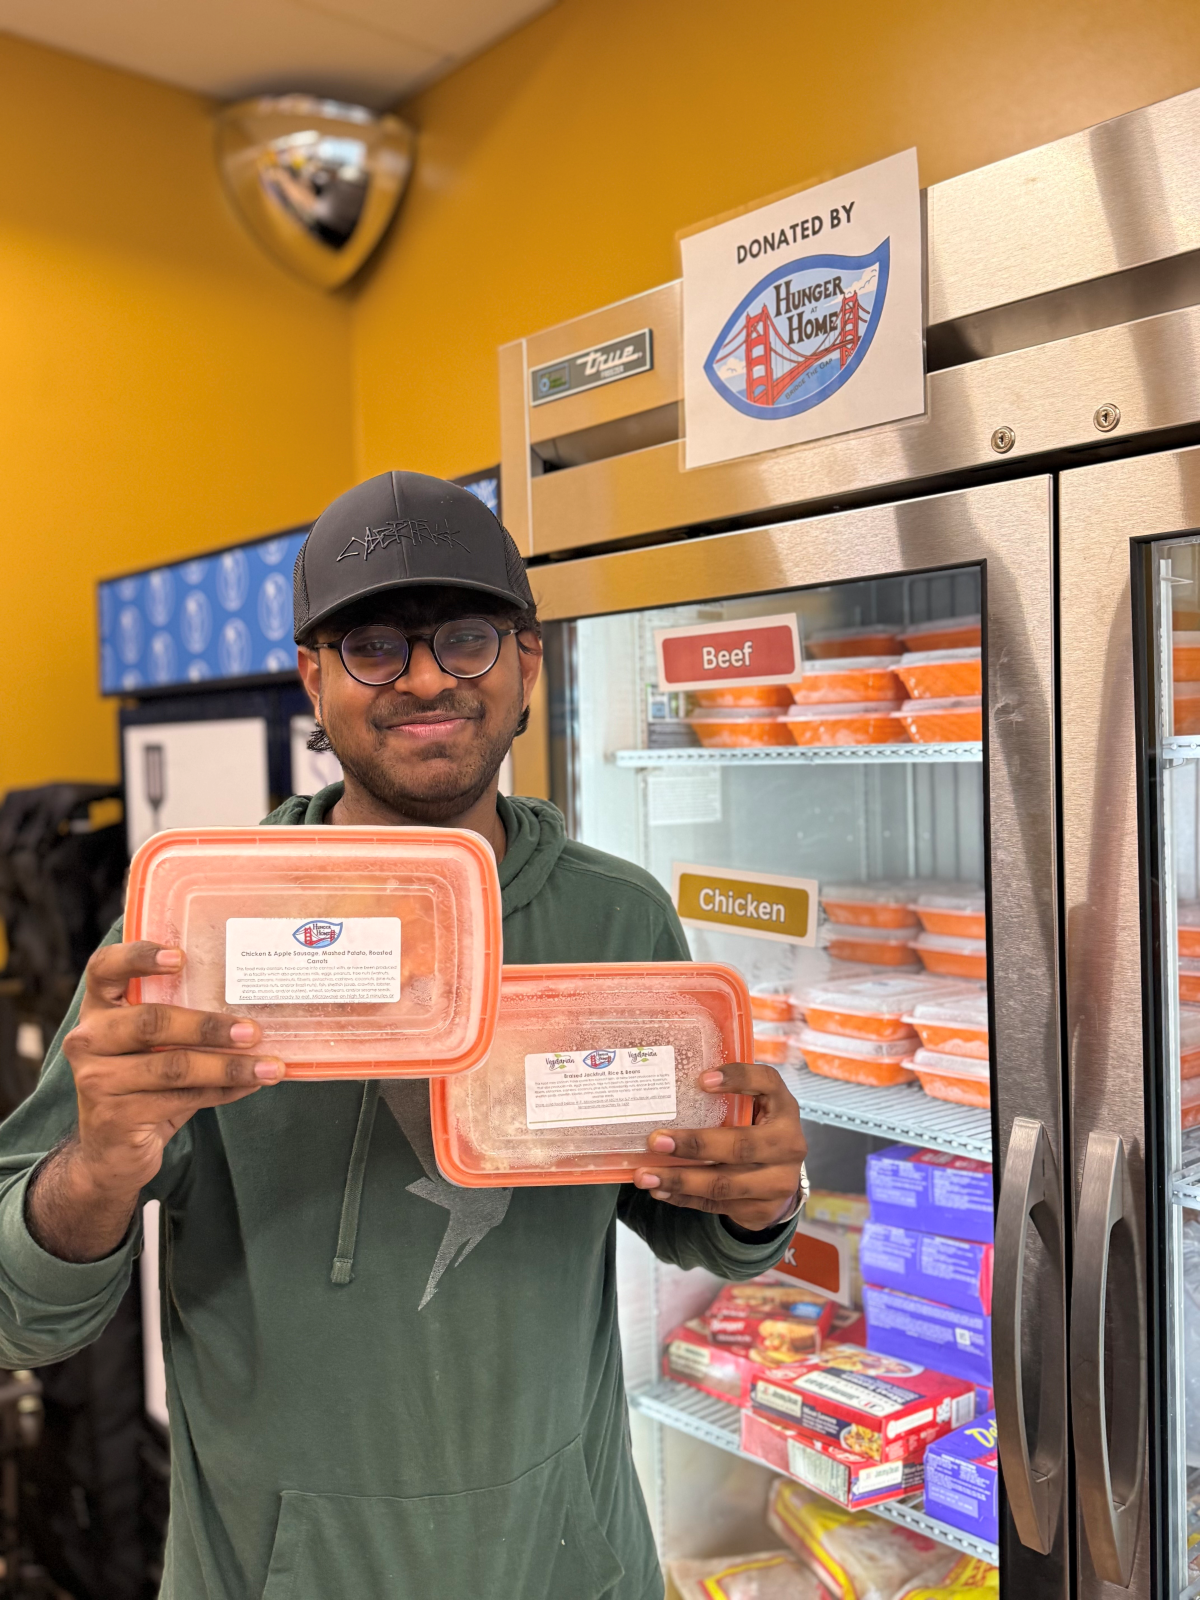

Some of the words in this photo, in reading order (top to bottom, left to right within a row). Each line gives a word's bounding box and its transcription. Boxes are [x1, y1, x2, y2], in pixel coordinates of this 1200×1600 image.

[736, 215, 823, 265] DONATED
[829, 201, 856, 230] BY
[773, 275, 846, 318] HUNGER
[787, 311, 839, 345] HOME
[702, 641, 753, 670] Beef
[699, 887, 786, 923] Chicken
